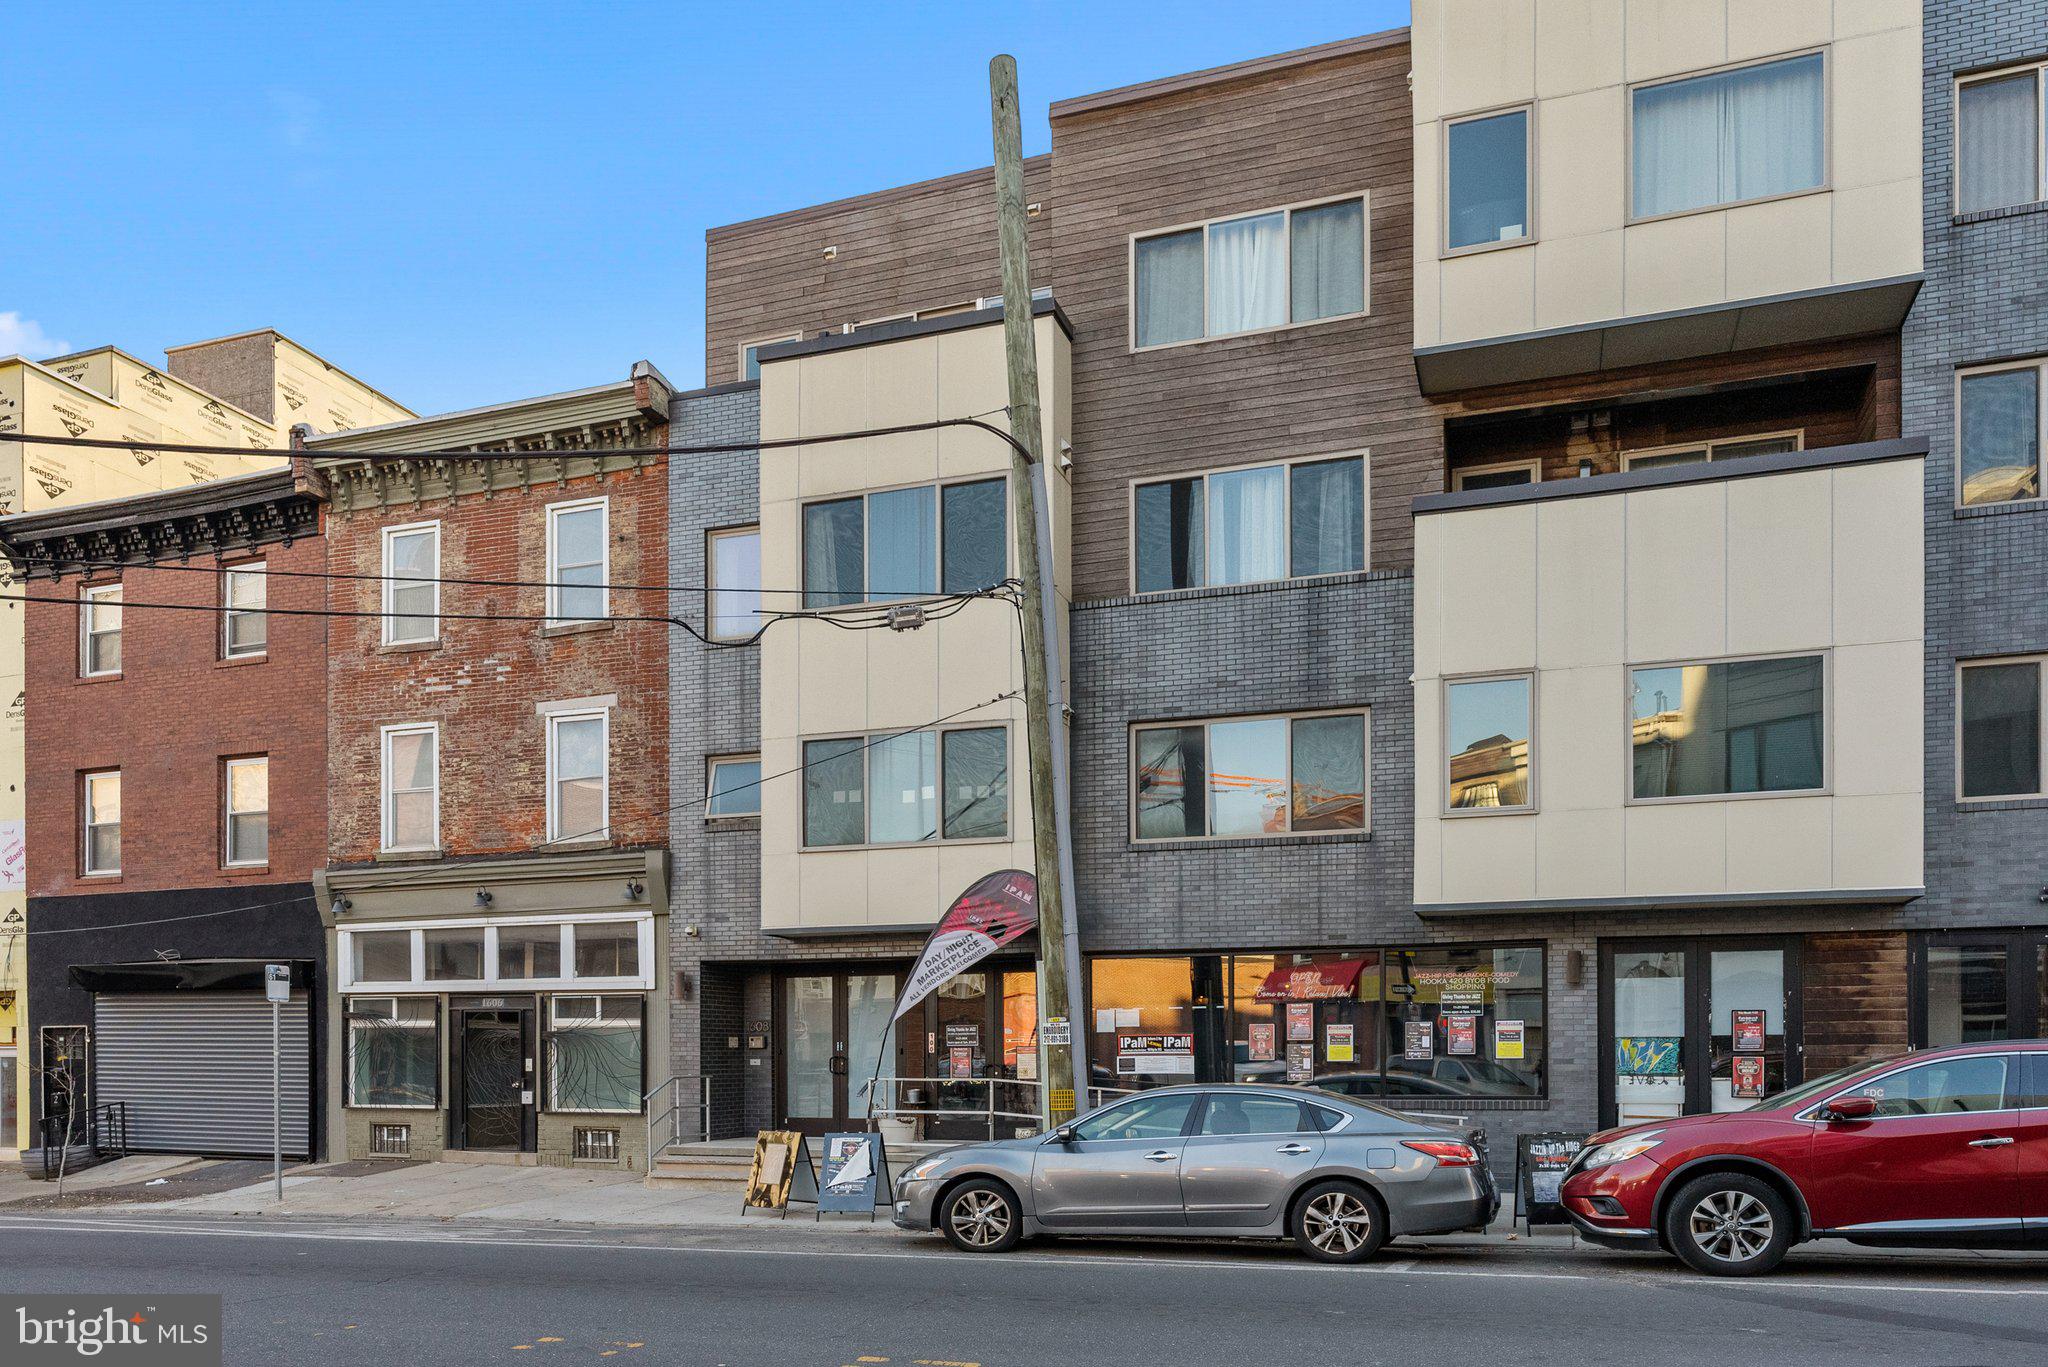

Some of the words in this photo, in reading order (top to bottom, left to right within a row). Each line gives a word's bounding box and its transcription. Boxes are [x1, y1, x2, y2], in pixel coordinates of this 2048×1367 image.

[135, 379, 173, 403] DensGlass
[52, 403, 95, 428] DensGlass
[197, 409, 233, 431] DensGlass
[29, 465, 72, 489] DensGlass
[924, 933, 974, 968] DAY/NIGHT
[909, 991, 921, 1002] ALL
[920, 971, 950, 992] VENDORS
[949, 946, 988, 972] WELCOMED
[916, 940, 981, 986] MARKETPLACE
[1043, 1026, 1069, 1035] EMBROIDERY
[1120, 1036, 1147, 1048] IPaM
[1163, 1036, 1190, 1048] IPaM
